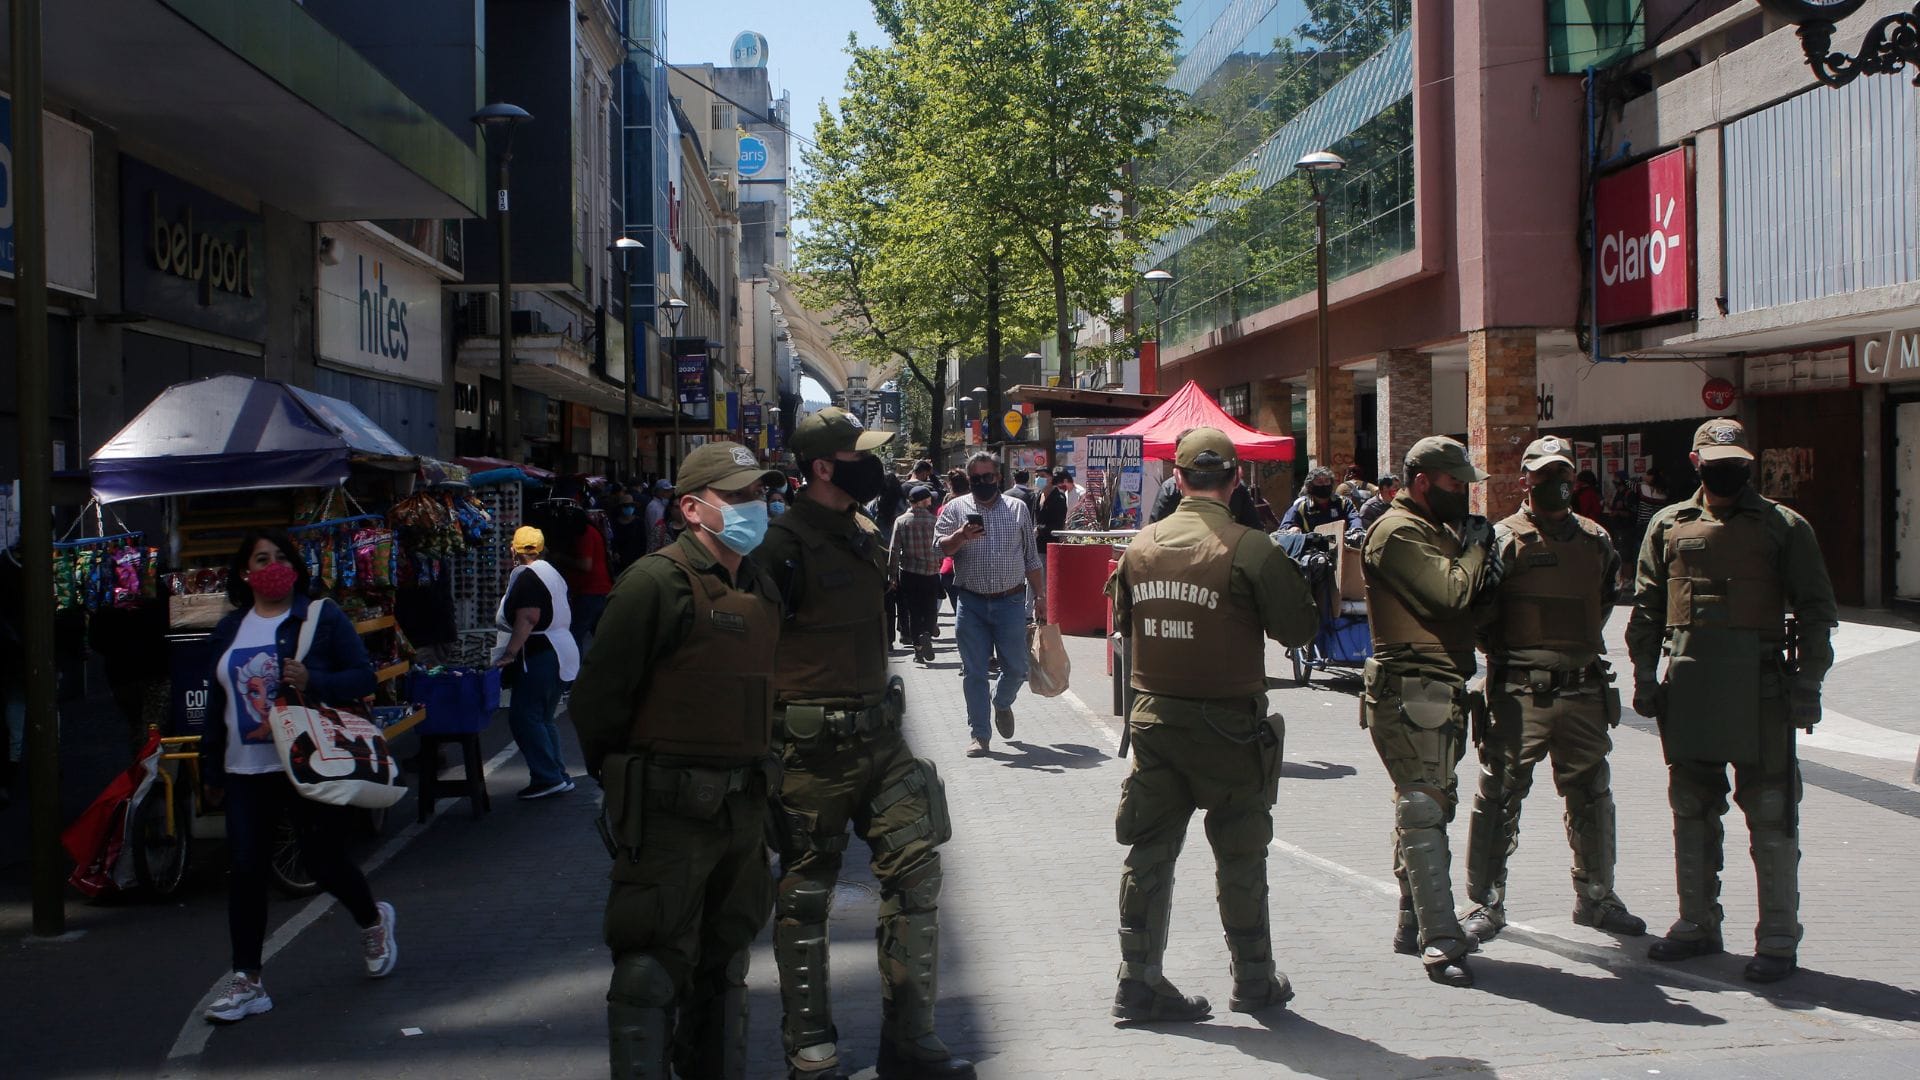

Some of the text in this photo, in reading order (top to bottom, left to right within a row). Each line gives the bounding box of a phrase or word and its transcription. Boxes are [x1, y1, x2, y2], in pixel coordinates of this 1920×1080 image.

[736, 46, 758, 62] paris
[738, 150, 764, 161] aris
[152, 193, 255, 306] belsport
[1600, 228, 1666, 287] Claro
[358, 253, 409, 363] hites
[1864, 328, 1919, 378] C/M
[678, 366, 696, 374] 2020
[1088, 439, 1140, 457] FIRMA POR
[1144, 618, 1194, 639] DE CHILE
